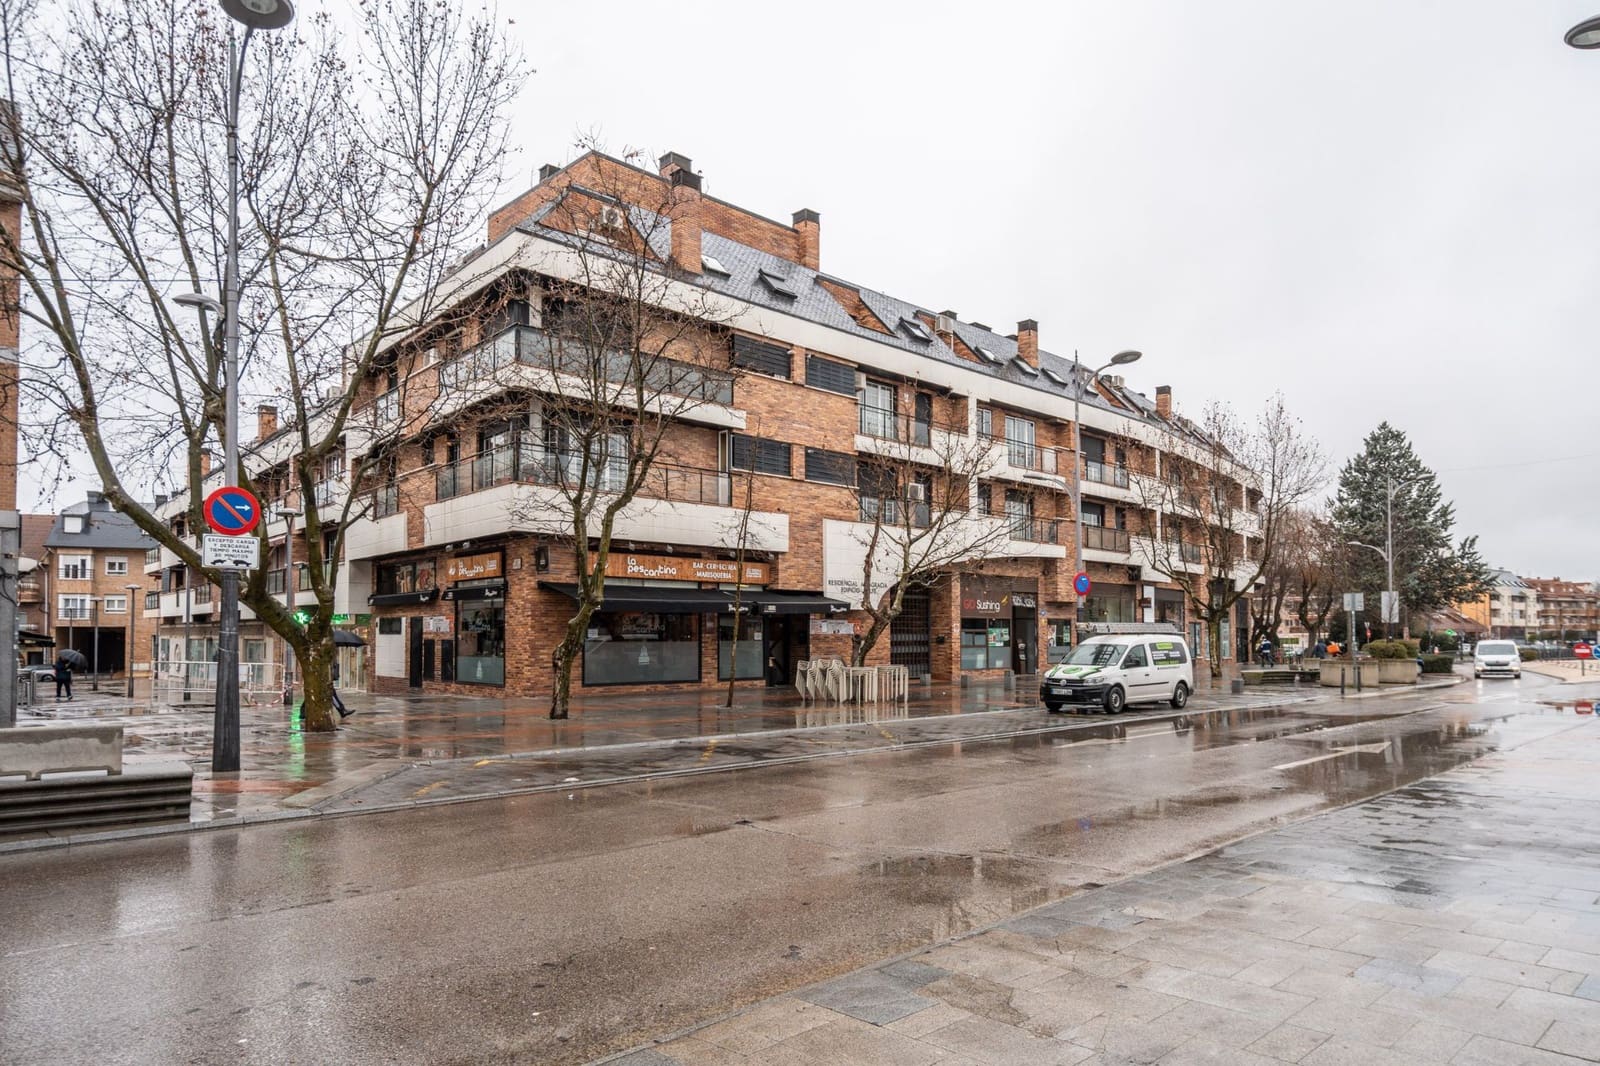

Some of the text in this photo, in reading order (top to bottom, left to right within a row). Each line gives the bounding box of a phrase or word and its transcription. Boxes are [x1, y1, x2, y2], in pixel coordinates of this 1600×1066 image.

[627, 556, 637, 566] la
[692, 561, 704, 569] BAR
[976, 599, 1000, 613] Sushing
